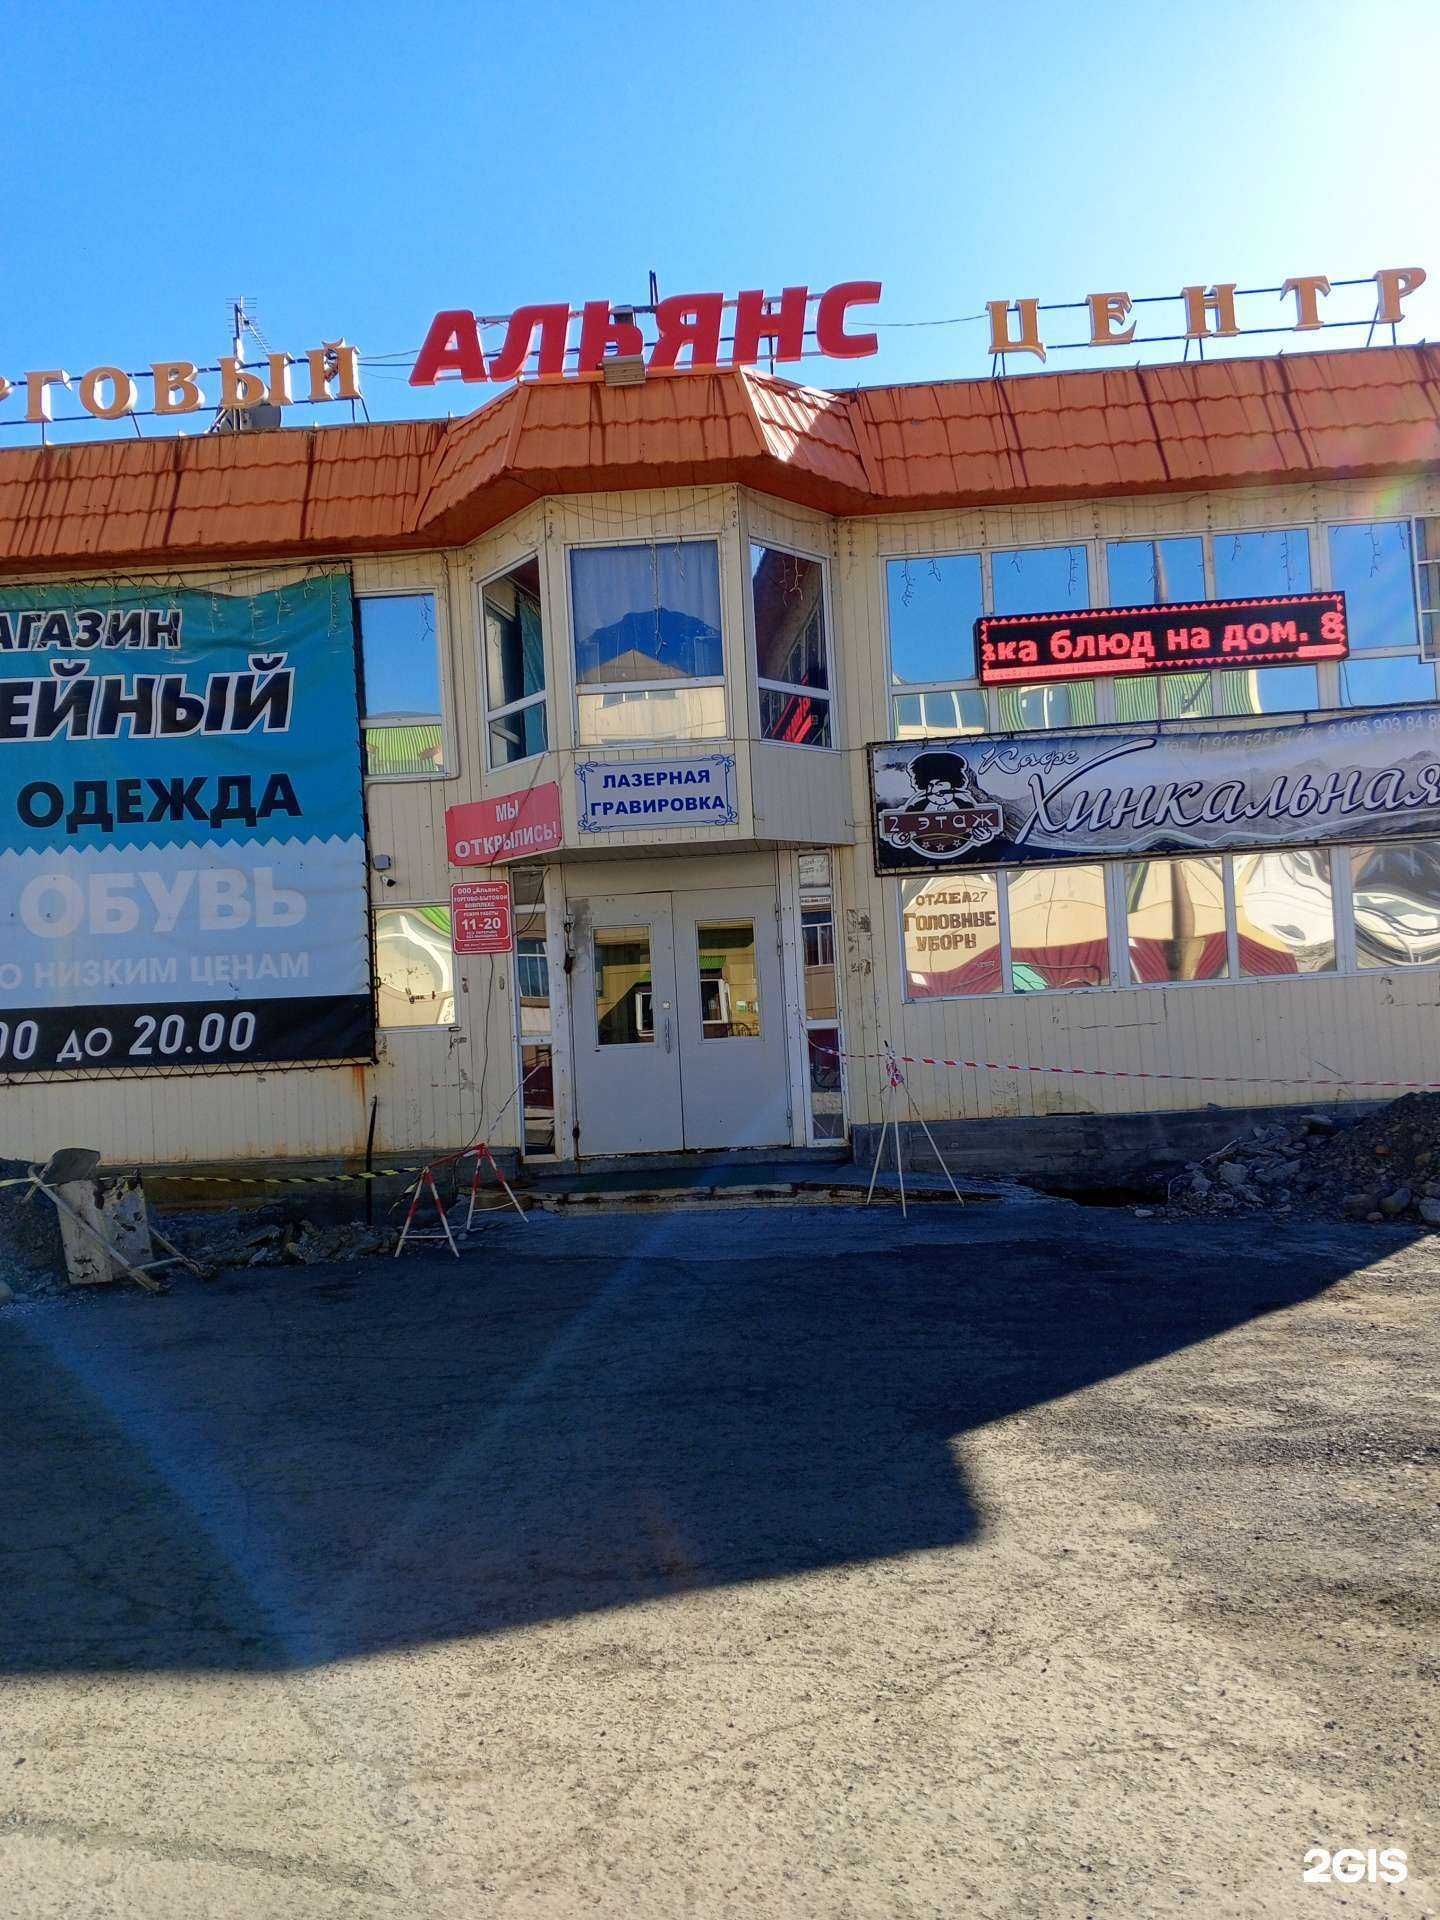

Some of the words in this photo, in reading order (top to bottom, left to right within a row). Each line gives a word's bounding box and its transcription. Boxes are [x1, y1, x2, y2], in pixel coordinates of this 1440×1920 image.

[408, 281, 882, 386] АЛЬЯНС
[985, 267, 1427, 364] ЦЕНТР
[0, 338, 362, 424] ГОВЫЙ
[1050, 629, 1156, 658] блюд
[1167, 627, 1210, 651] на
[1222, 618, 1308, 651] дом.
[1321, 611, 1344, 640] 8
[0, 652, 296, 742] ЕЙНЫЙ
[602, 769, 710, 789] ЛАЗЕРНАЯ
[978, 746, 1079, 775] Кафе
[17, 773, 303, 834] ОДЕЖДА
[591, 795, 725, 816] ГРАВИРОВКА
[1014, 740, 1440, 845] Хинкальная
[455, 821, 558, 858] ОТКРЫЛИСЬ!
[889, 816, 899, 832] 2
[20, 867, 307, 938] ОБУВЬ
[34, 957, 177, 989] НИЗКИМ
[190, 952, 310, 986] ЦЕНАМ
[129, 1011, 256, 1055] 20.00
